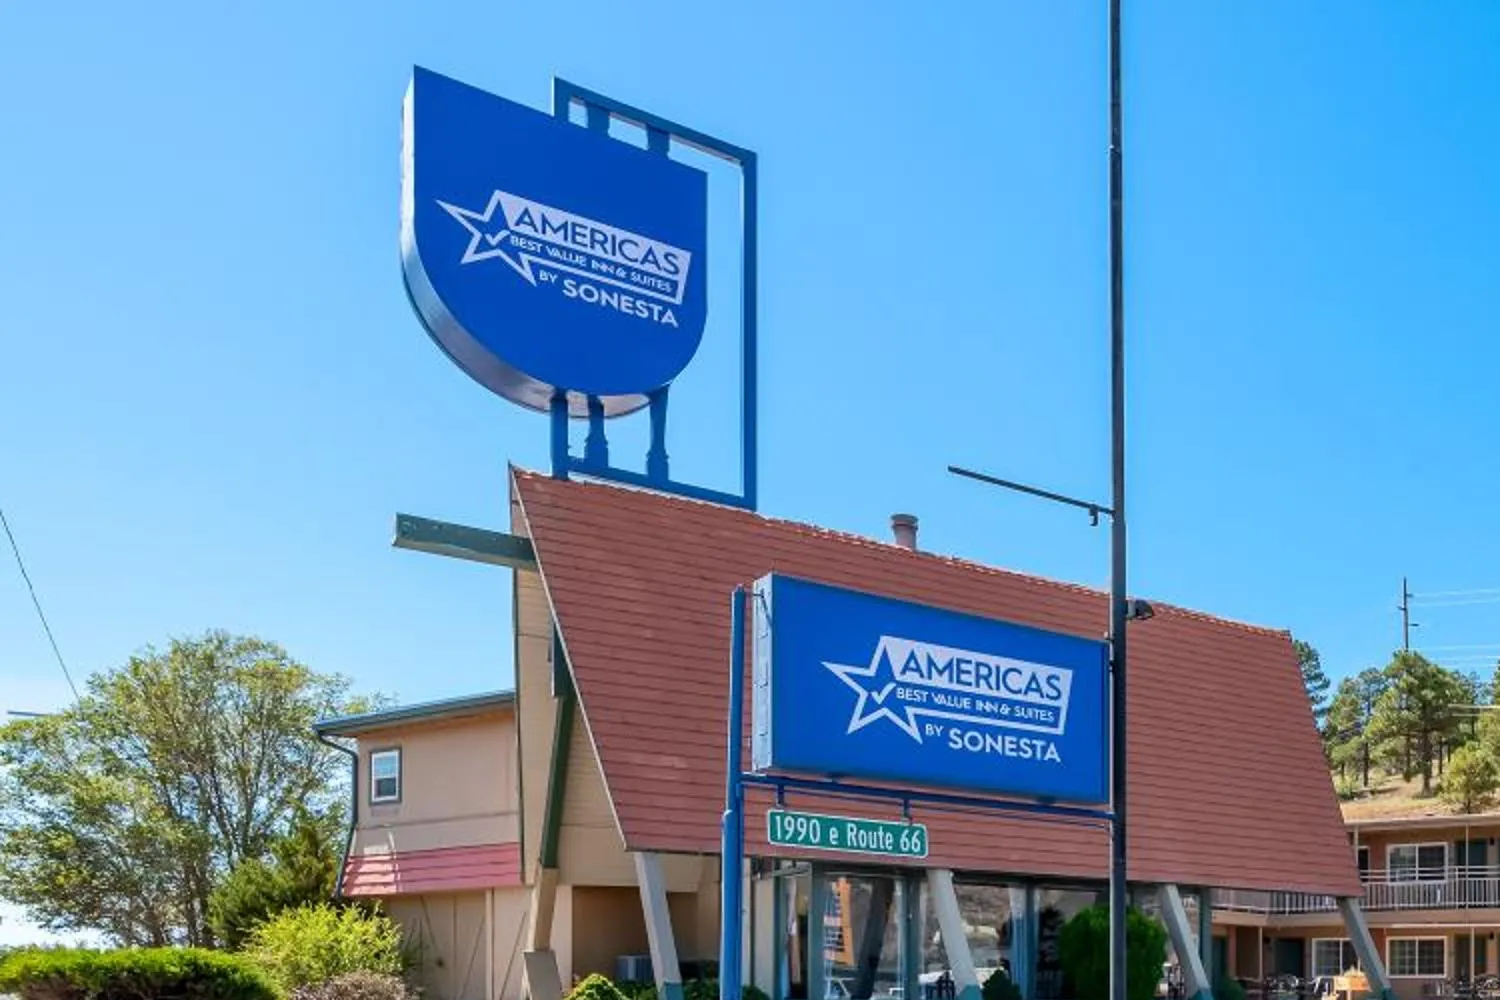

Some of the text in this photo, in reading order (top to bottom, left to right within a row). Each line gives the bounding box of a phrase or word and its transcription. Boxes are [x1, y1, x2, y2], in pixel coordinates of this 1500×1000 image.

[510, 235, 543, 253] BEST
[545, 246, 587, 267] VALUE
[630, 271, 672, 293] SUITES
[514, 207, 680, 276] AMERICAS
[539, 270, 679, 328] BY SONESTA
[900, 649, 1062, 700] AMERICAS
[896, 687, 928, 703] BEST
[931, 693, 972, 709] VALUE
[1014, 706, 1055, 723] SUITES
[925, 724, 1061, 763] BY SONESTA
[775, 815, 921, 852] 1990 e Route 66
